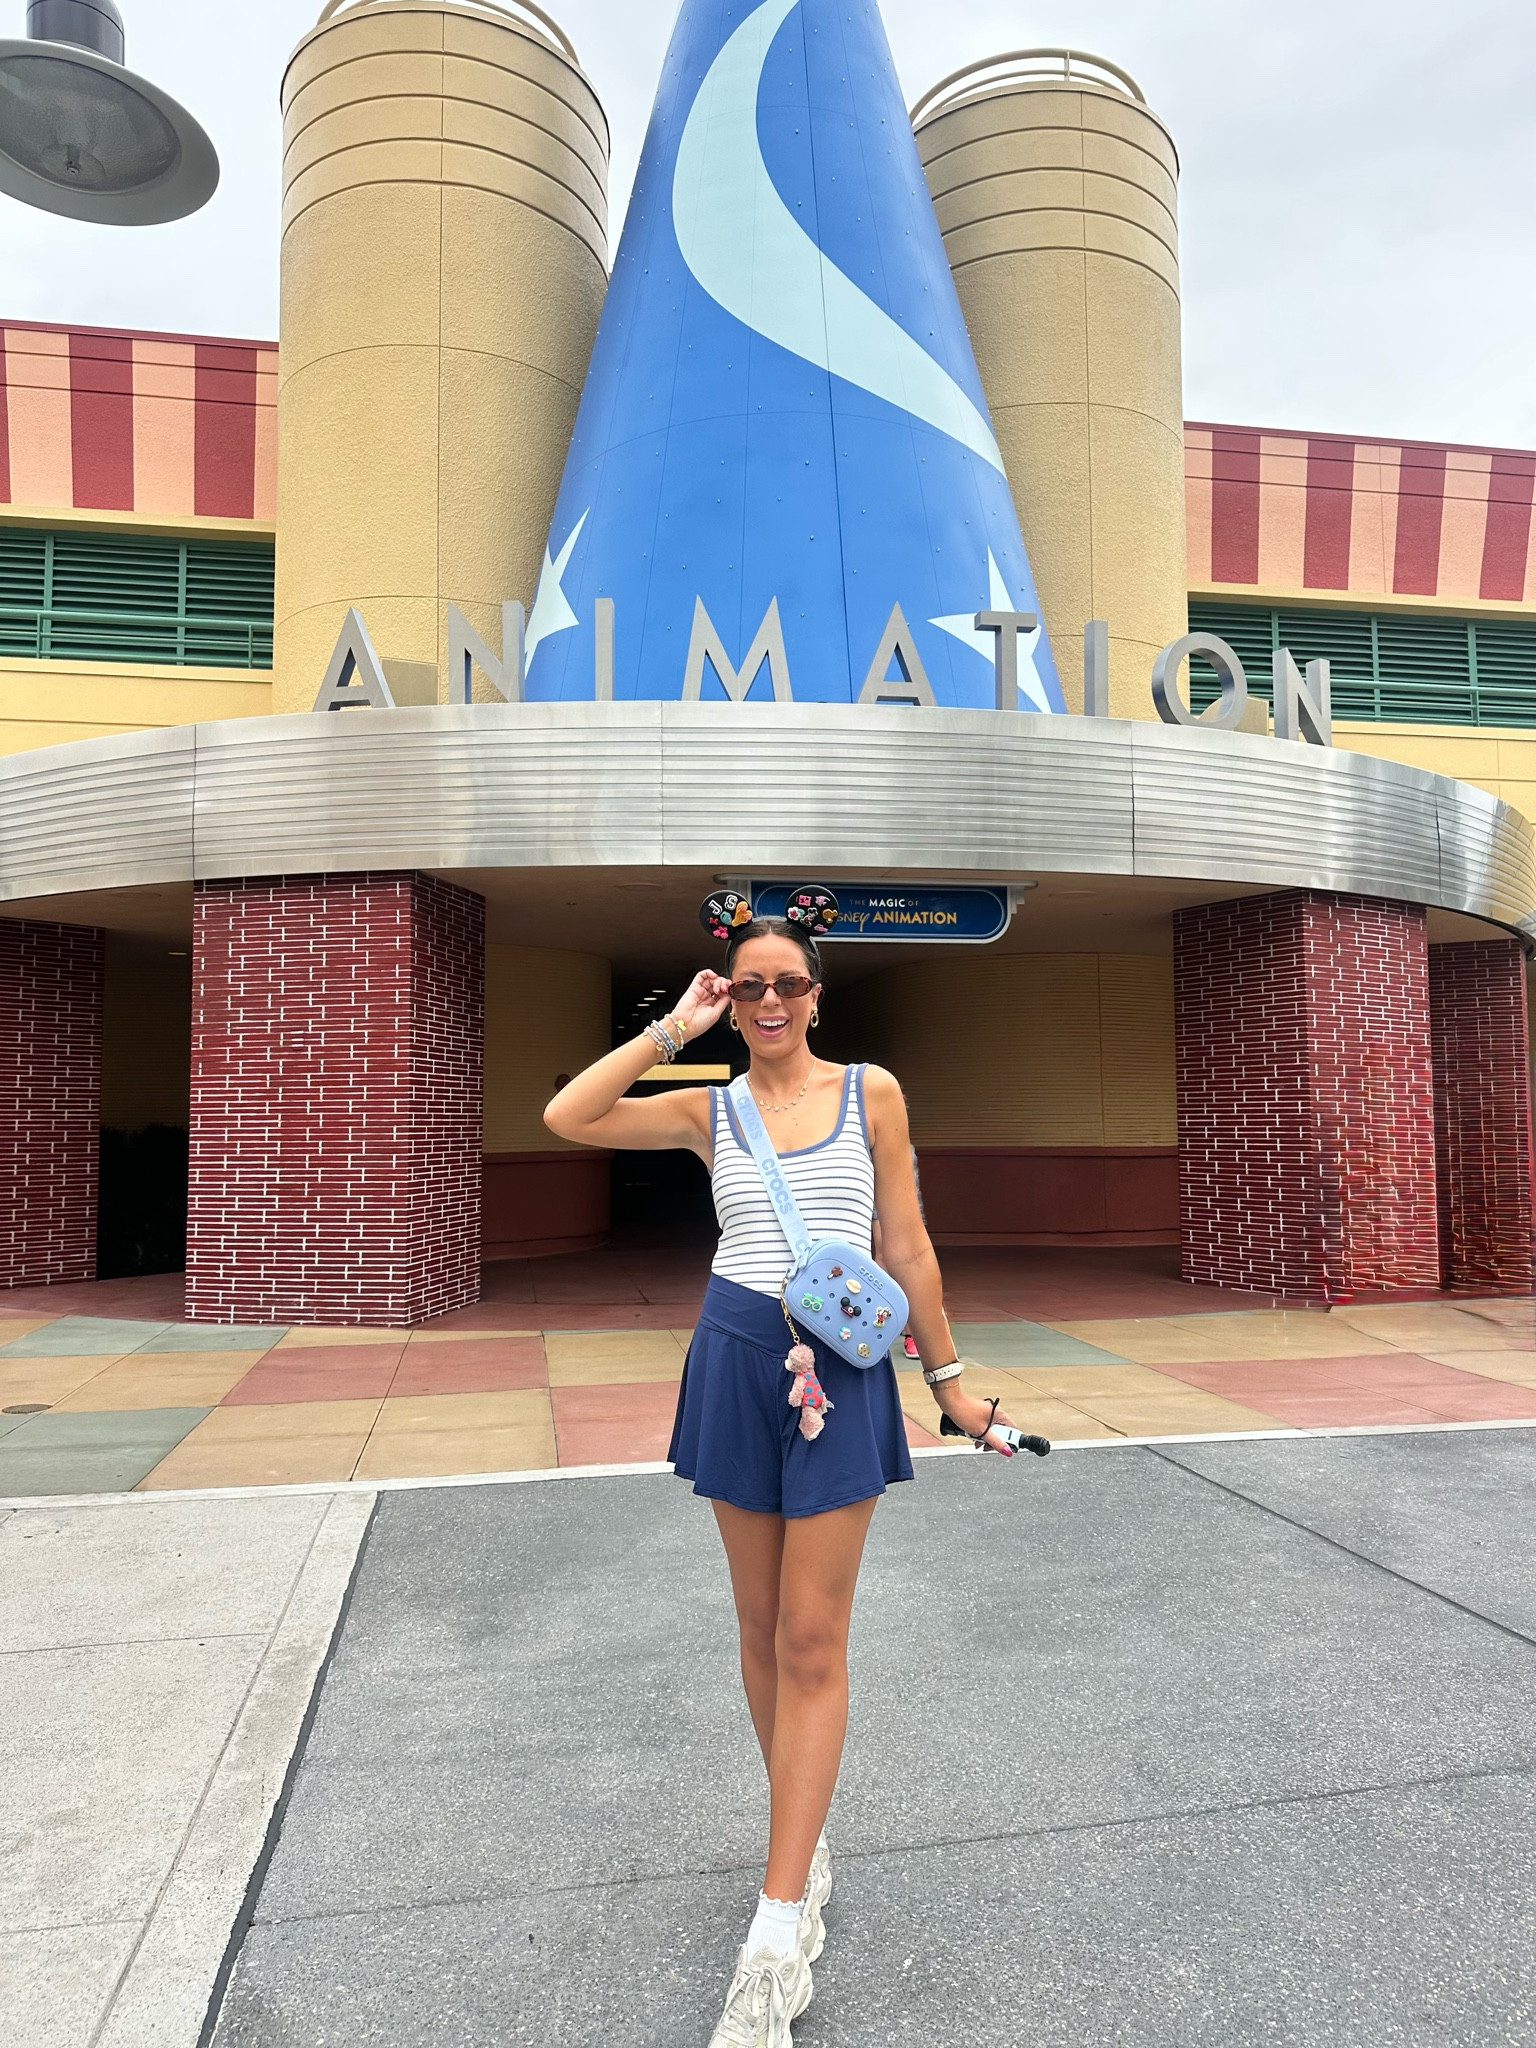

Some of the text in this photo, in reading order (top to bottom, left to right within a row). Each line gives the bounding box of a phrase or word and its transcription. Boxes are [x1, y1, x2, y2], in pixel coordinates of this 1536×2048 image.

[313, 594, 1332, 747] ANIMATION
[868, 898, 906, 908] MAGIC
[872, 911, 958, 925] ANIMATION
[761, 1158, 793, 1215] crocs
[859, 1266, 884, 1291] crocs
